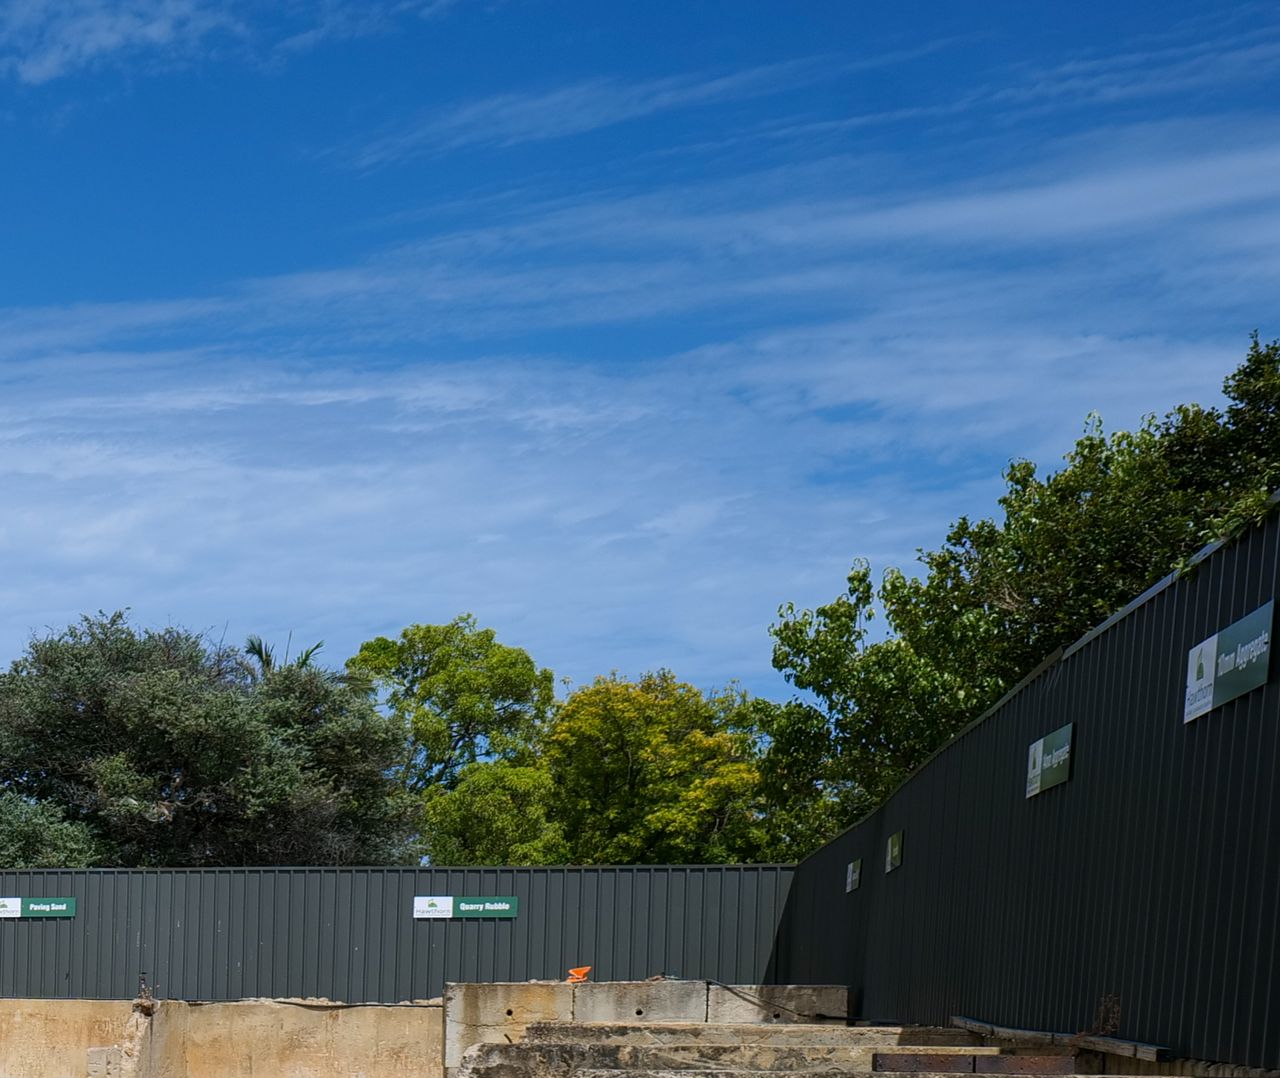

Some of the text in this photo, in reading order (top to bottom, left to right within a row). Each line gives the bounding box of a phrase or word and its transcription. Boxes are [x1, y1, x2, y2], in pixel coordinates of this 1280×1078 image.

[1235, 630, 1269, 671] Aggregate
[29, 903, 67, 912] Paving Sand
[459, 901, 510, 912] Quarry Rubble
